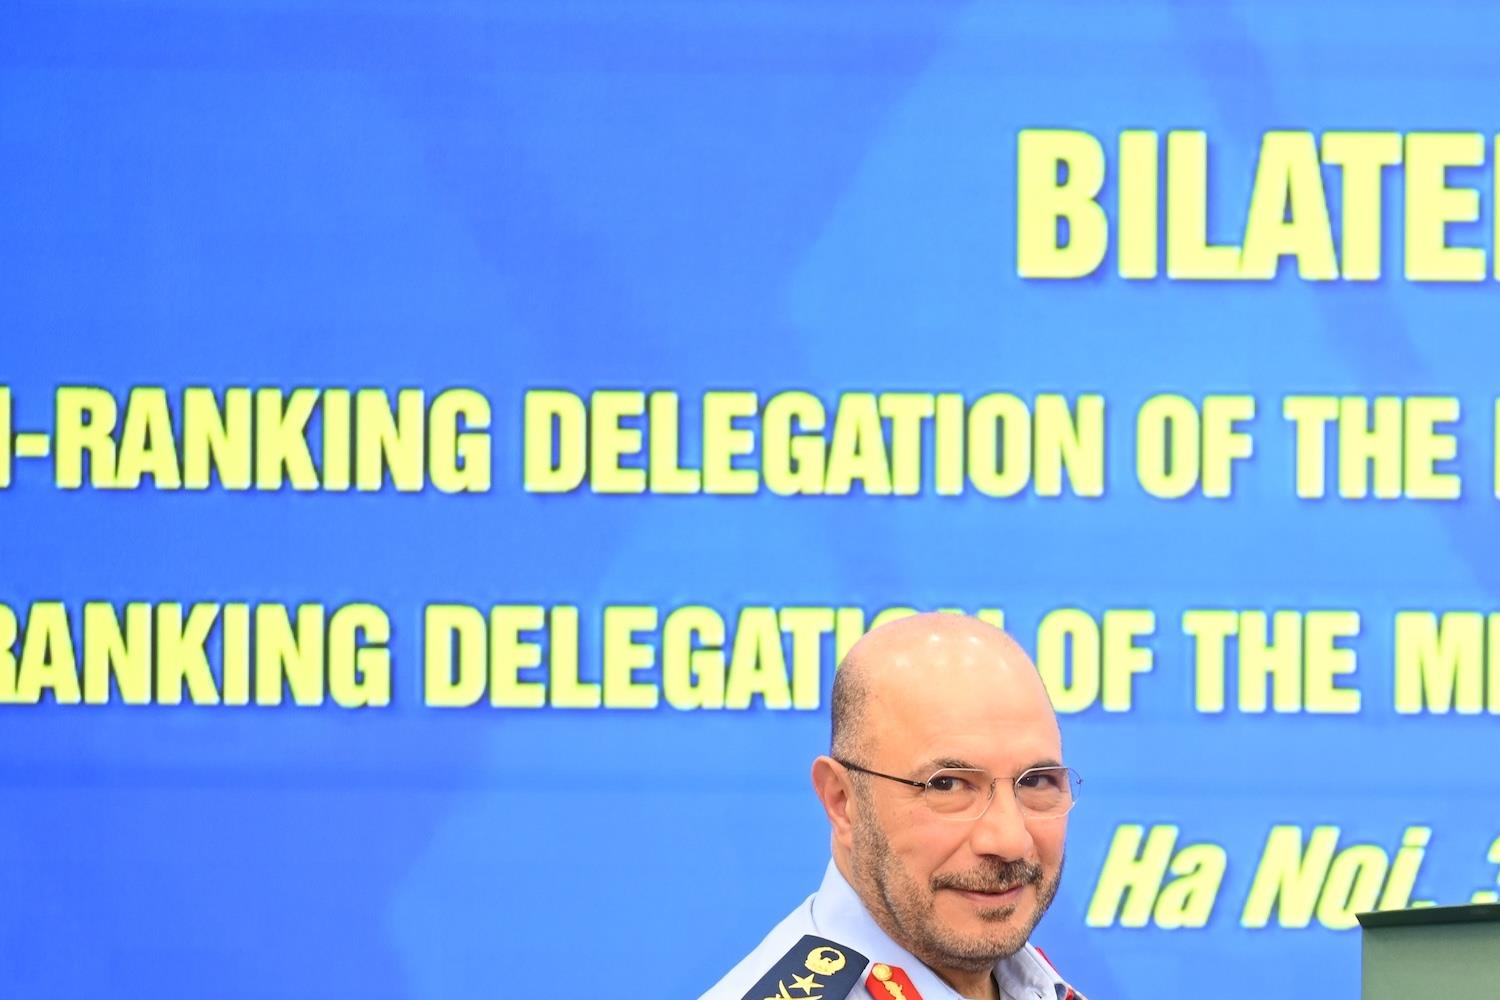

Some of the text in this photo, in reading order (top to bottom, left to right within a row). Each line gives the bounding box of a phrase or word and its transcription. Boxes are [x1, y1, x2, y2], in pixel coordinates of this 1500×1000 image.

[0, 386, 492, 494] -RANKING
[524, 390, 1106, 498] DELEGATION
[1136, 393, 1256, 499] OF
[1283, 395, 1462, 500] THE
[0, 601, 391, 706] ANKING
[425, 604, 1005, 711] DELEGAT
[1036, 607, 1156, 714] OF
[1182, 609, 1361, 714] THE
[1086, 824, 1227, 929] Ha
[1241, 825, 1438, 930] Noi
